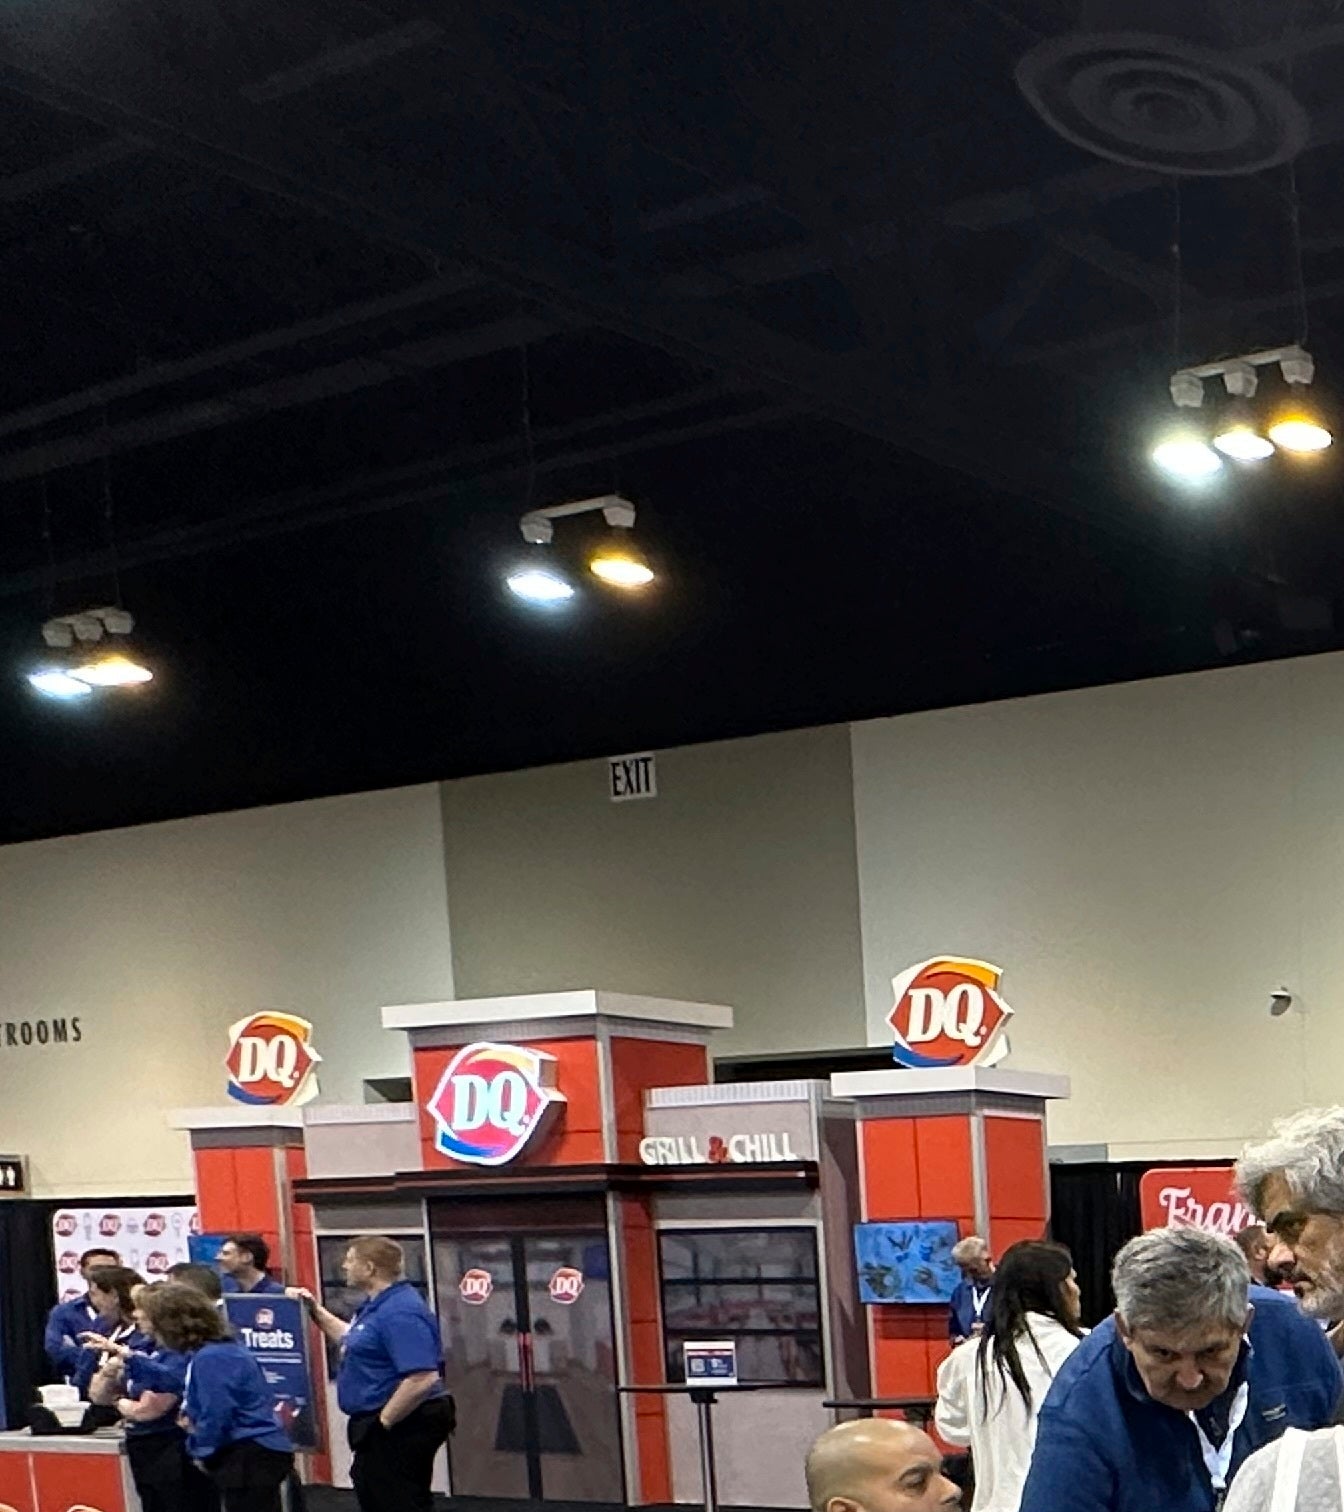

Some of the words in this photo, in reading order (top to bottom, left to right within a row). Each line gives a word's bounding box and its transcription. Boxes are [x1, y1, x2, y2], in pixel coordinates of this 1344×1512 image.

[611, 757, 653, 796] EXIT
[0, 1016, 82, 1047] ROOMS
[907, 983, 982, 1047] DQ
[238, 1034, 298, 1088] DQ
[451, 1071, 529, 1136] DQ
[639, 1136, 706, 1165] GRILL
[708, 1135, 728, 1163] &
[728, 1133, 799, 1162] CHILL
[241, 1328, 294, 1349] Treats
